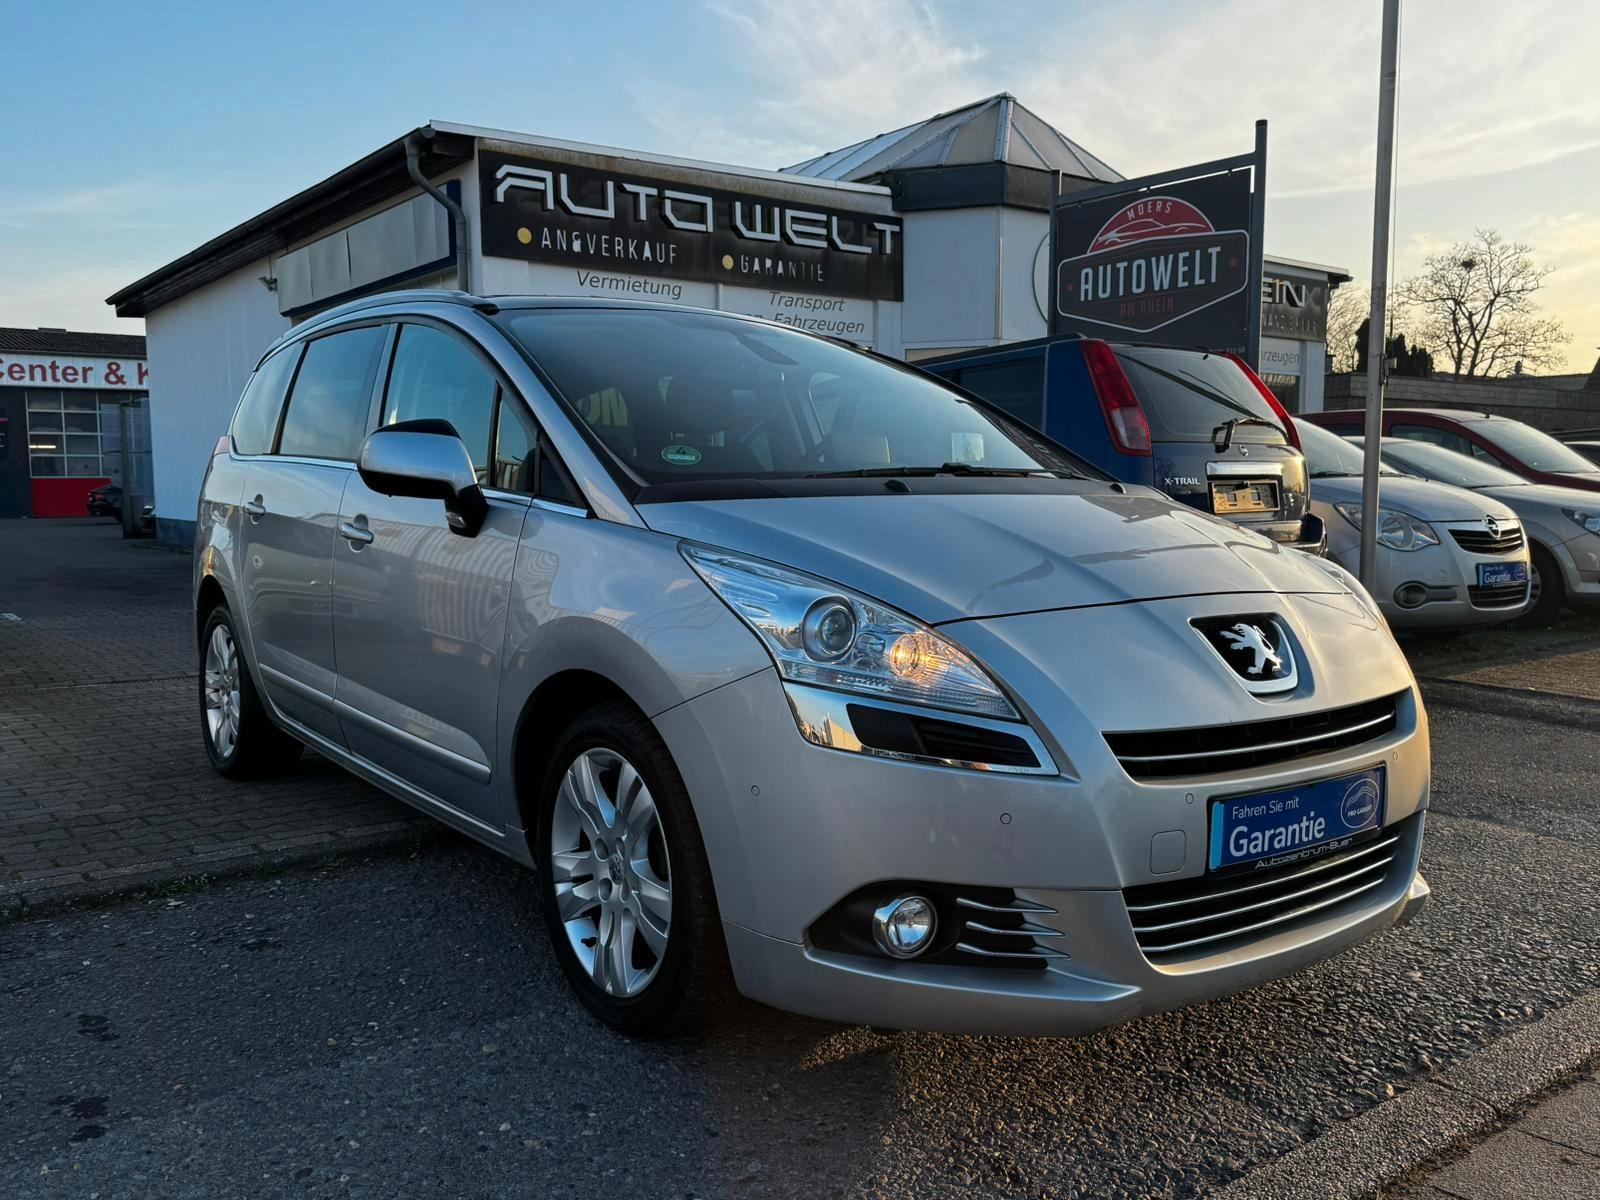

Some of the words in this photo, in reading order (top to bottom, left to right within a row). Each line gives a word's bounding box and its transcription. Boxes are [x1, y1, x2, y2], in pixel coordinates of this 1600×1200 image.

[495, 164, 713, 233] AUTO
[733, 201, 900, 254] WELT
[1127, 201, 1173, 221] MOERS
[741, 255, 824, 282] GARANTIE
[1080, 246, 1221, 302] AUTOWELT
[577, 270, 682, 300] Vermietung
[770, 292, 845, 312] Transport
[104, 361, 127, 385] &
[1164, 477, 1201, 486] X-TRAIL
[1484, 571, 1511, 584] Garantie
[1232, 802, 1266, 820] Fahren
[1269, 799, 1283, 813] Sie
[1285, 796, 1300, 810] mit
[1229, 811, 1326, 857] Garantie
